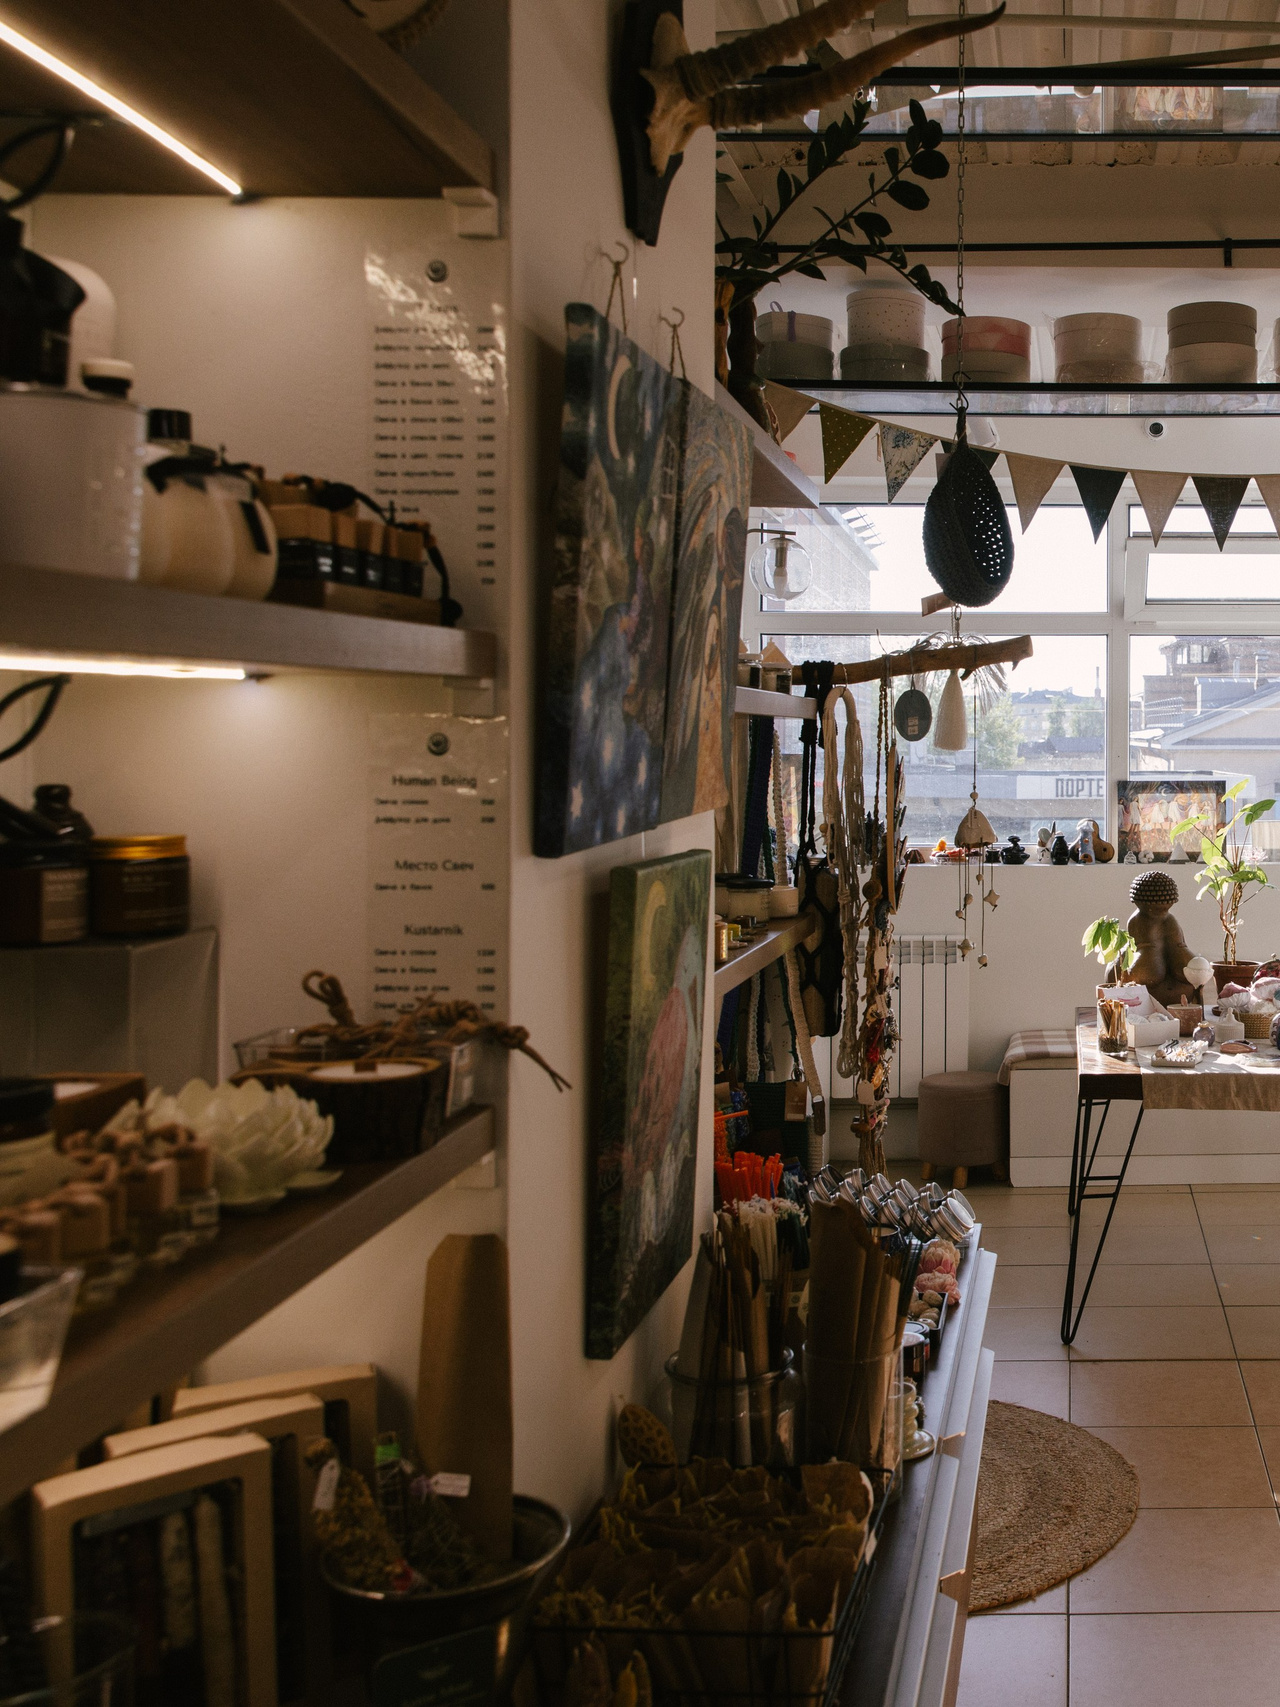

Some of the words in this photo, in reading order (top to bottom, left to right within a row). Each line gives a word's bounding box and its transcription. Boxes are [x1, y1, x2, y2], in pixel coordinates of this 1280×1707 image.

[392, 774, 437, 787] Human
[441, 774, 477, 789] Being
[395, 860, 438, 872] Место
[443, 860, 475, 872] Свеч
[403, 923, 464, 936] Kustarnik
